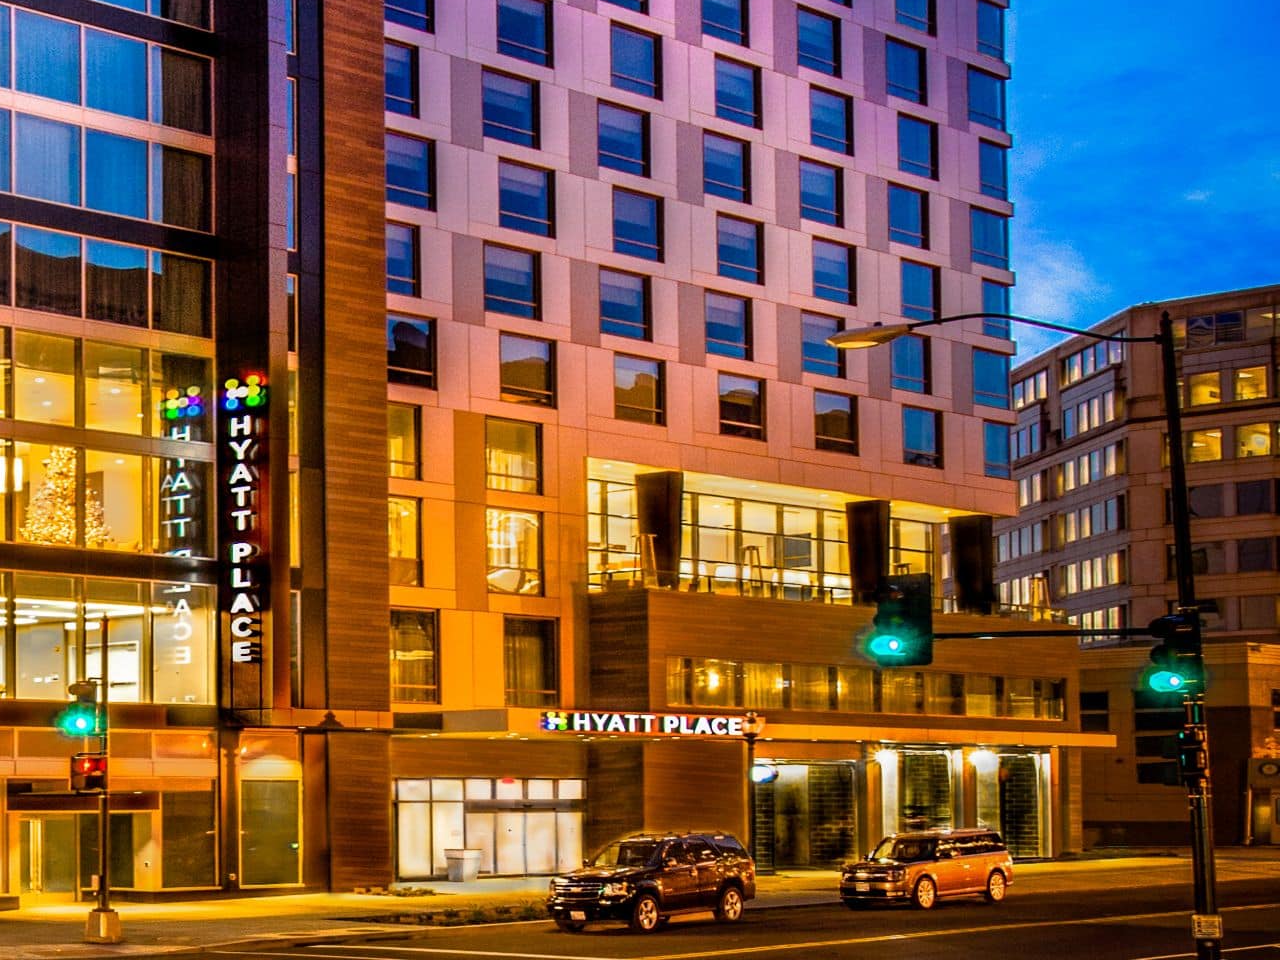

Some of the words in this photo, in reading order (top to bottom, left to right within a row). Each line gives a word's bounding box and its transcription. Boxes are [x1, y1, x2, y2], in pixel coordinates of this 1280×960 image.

[229, 414, 252, 531] HYATT
[229, 543, 254, 663] PLACE
[573, 714, 656, 732] HYATT
[663, 716, 743, 736] PLACE
